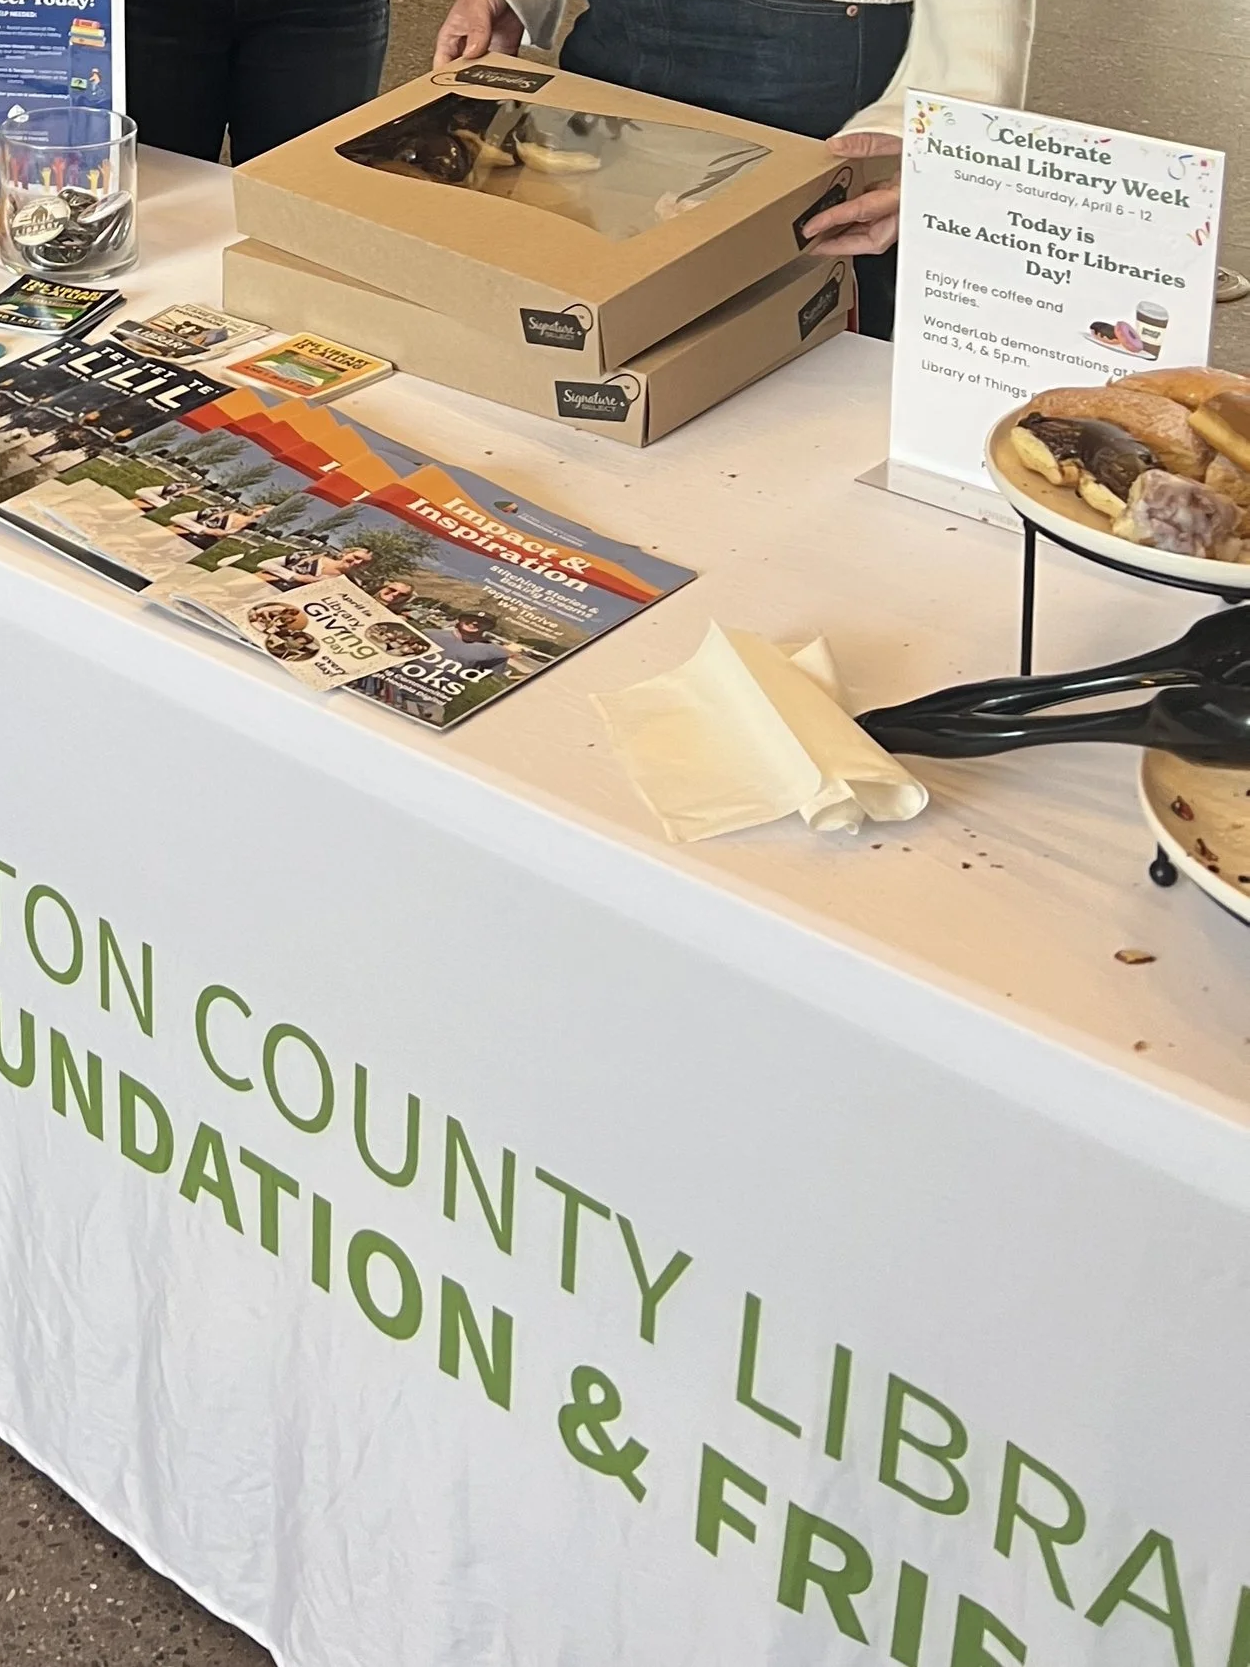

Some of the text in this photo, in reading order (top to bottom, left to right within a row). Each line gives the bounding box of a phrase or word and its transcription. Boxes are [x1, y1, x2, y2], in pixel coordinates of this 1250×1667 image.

[999, 128, 1112, 165] Celebrate
[927, 137, 1190, 209] National Library Week
[954, 169, 1001, 191] Sunday
[1016, 183, 1078, 208] Saturday,
[1082, 197, 1112, 214] April
[1116, 204, 1124, 215] 6
[1140, 209, 1152, 222] 12
[15, 221, 64, 237] LIBRARY
[1007, 211, 1095, 244] Today is
[923, 213, 1186, 289] Take Action for Libraries
[1026, 260, 1071, 284] Day!
[924, 285, 979, 309] pastries.
[925, 269, 1064, 313] Enjoy free coffee and
[132, 328, 192, 351] LIBRARY
[529, 316, 575, 336] Signature
[308, 348, 366, 370] CALLING
[325, 347, 373, 365] LIBRARY
[923, 314, 1128, 378] WonderLab demonstrations at
[923, 330, 1030, 368] and 3, 4, & 5p.m.
[921, 359, 1027, 398] Library of Things
[563, 389, 618, 408] Signature
[581, 403, 616, 412] SELECT
[406, 497, 589, 593] Inspiration
[442, 497, 559, 560] Impact
[558, 557, 593, 575] &
[339, 592, 372, 617] April is
[482, 585, 538, 611] Together
[490, 565, 545, 593] Stitching
[545, 589, 589, 610] Stories
[500, 576, 543, 599] Baking
[543, 595, 594, 618] Dreams
[303, 602, 378, 660] Giving
[321, 597, 365, 631] Library
[498, 600, 558, 628] We Thrive
[321, 637, 350, 655] Day
[321, 655, 346, 675] every
[194, 984, 693, 1343] COUNTY
[736, 1291, 1250, 1667] LIBRA
[556, 1365, 650, 1502] &
